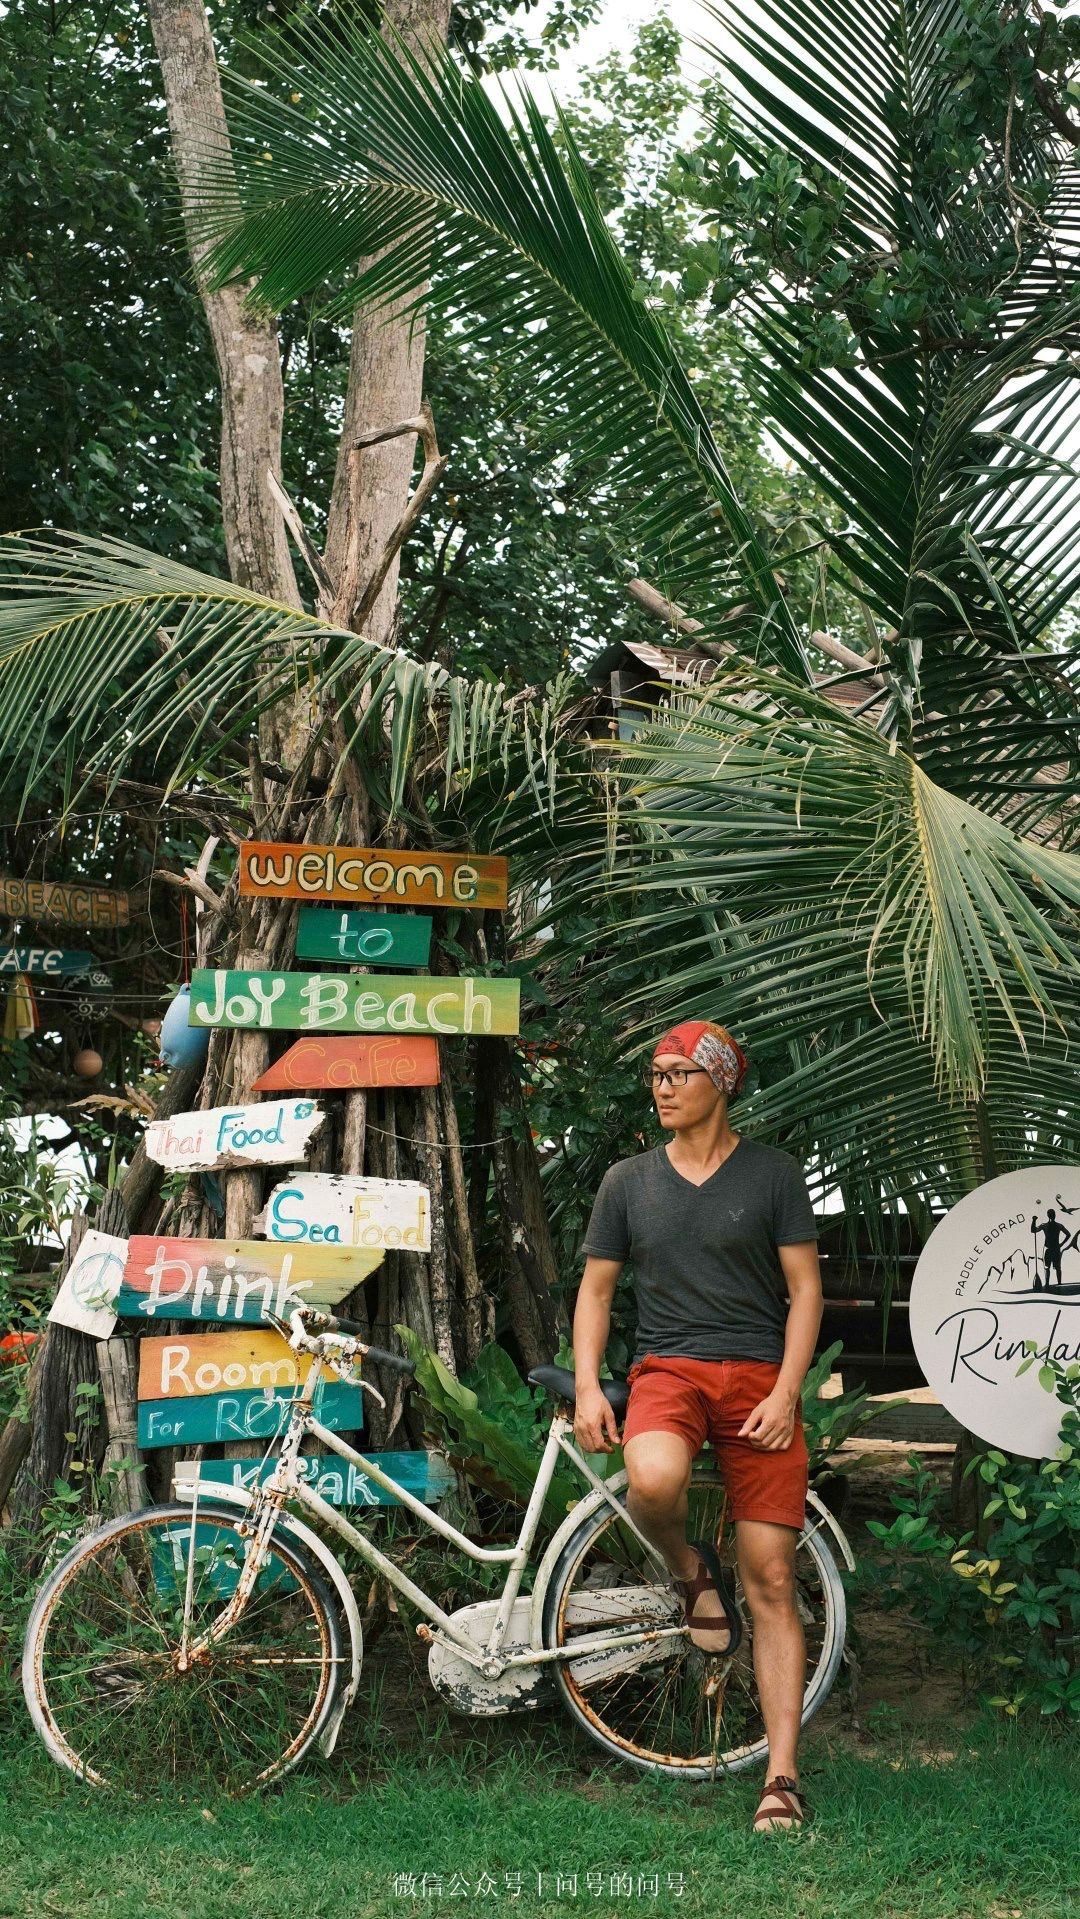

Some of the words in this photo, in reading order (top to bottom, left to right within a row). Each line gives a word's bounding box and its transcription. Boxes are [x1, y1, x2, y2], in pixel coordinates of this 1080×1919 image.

[248, 852, 479, 900] welcome
[4, 878, 118, 927] BEACH
[331, 914, 393, 957] to
[300, 975, 492, 1033] Beach
[151, 1122, 203, 1157] Thai
[216, 1108, 285, 1151] Food
[272, 1189, 343, 1242] Sea
[353, 1195, 427, 1247] Food
[138, 1245, 313, 1319] Drink
[955, 1245, 983, 1296] PADDLE
[161, 1346, 295, 1393] Room
[148, 1411, 184, 1439] For
